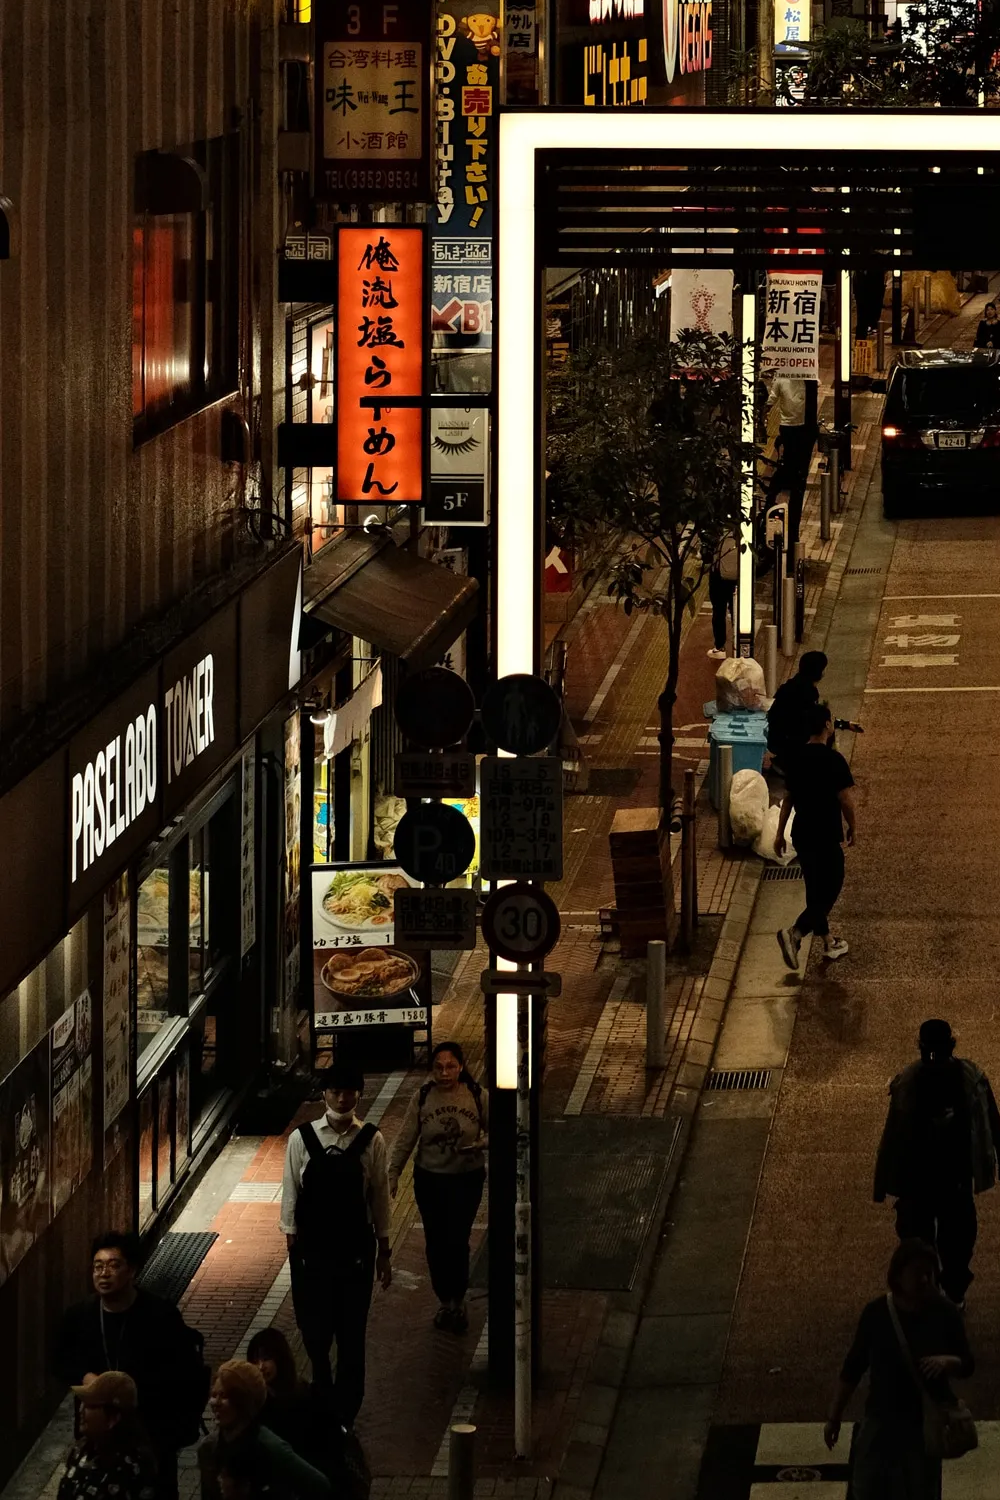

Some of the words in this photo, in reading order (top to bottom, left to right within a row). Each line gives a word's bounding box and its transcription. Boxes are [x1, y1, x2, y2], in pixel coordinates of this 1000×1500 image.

[327, 48, 419, 70] 台湾料理
[337, 131, 409, 150] 小酒館
[433, 273, 492, 294] 新宿店
[767, 289, 817, 316] 新宿
[766, 317, 816, 344] 本店
[356, 236, 405, 496] 俺流塩らーめん
[789, 358, 815, 368] OPEN
[443, 491, 469, 511] 5F
[72, 703, 157, 883] PASELABO
[165, 653, 215, 785] TOWER
[501, 906, 542, 940] 30
[314, 934, 364, 947] ゆず塩
[402, 1010, 425, 1021] 1580
